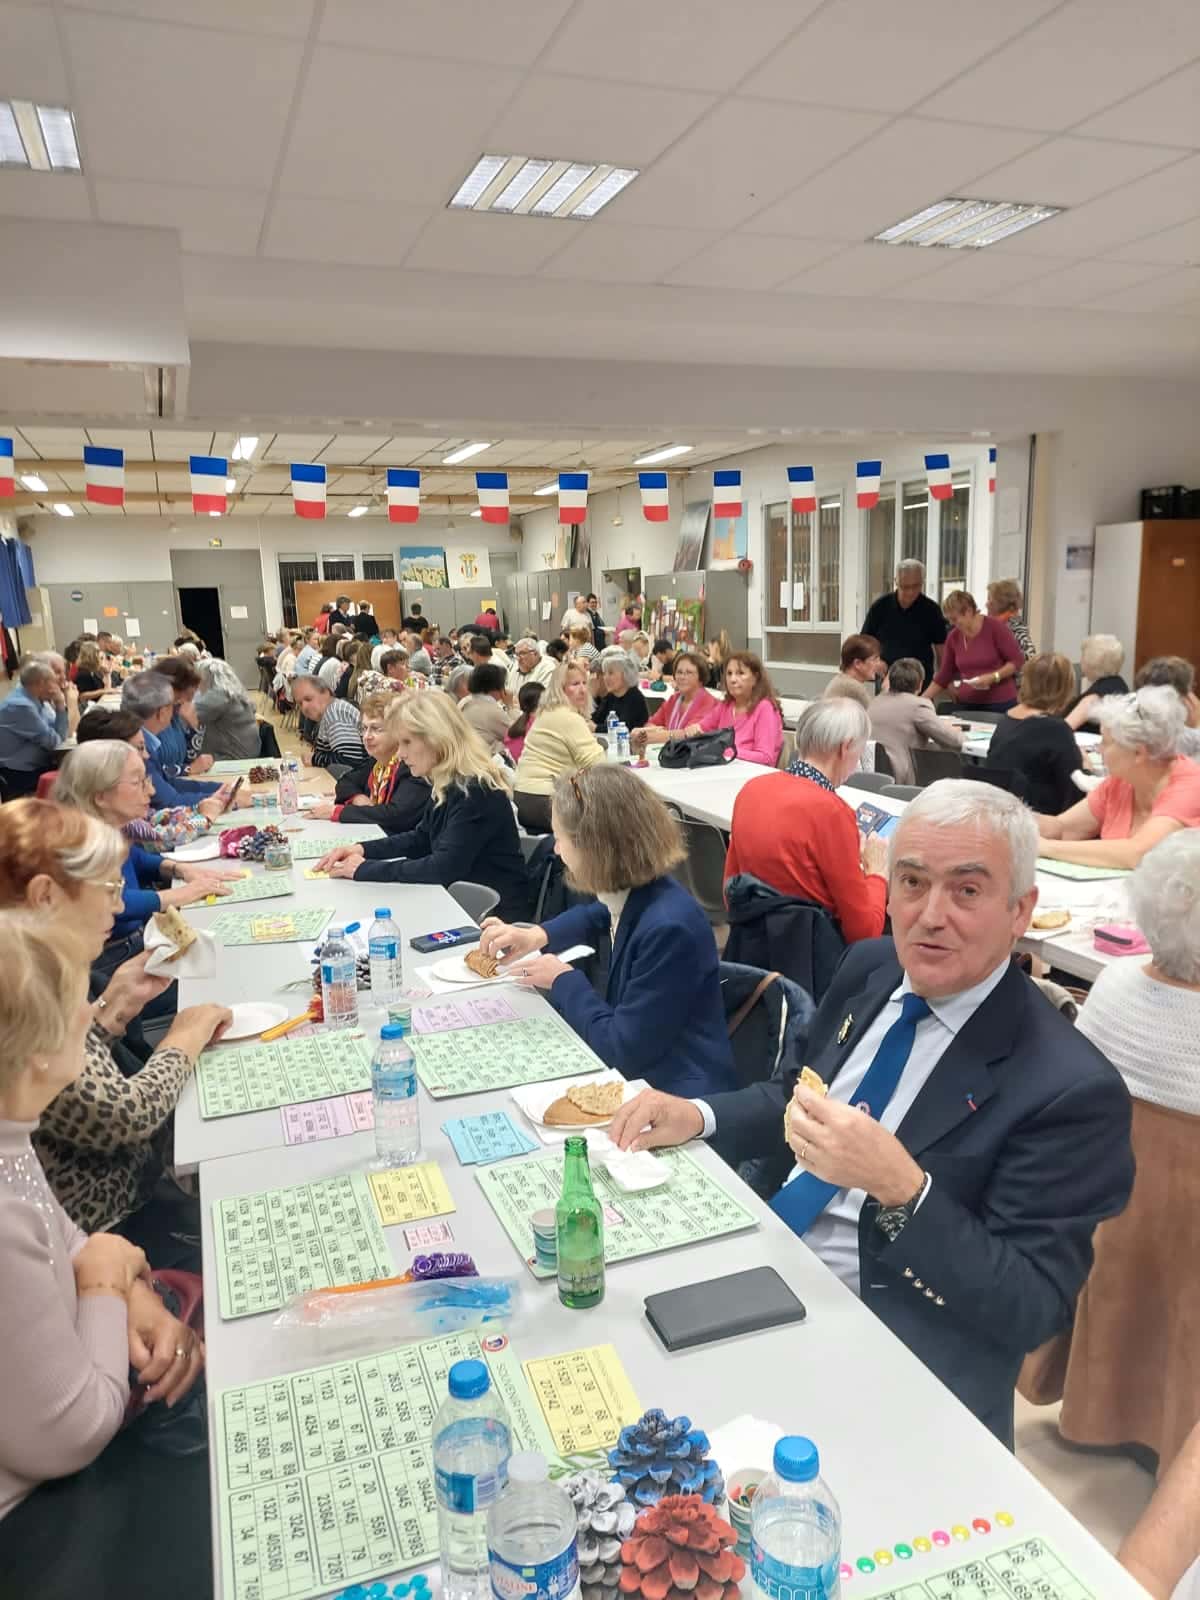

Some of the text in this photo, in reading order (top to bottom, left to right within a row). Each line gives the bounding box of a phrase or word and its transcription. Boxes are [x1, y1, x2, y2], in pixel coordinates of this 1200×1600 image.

[366, 1368, 378, 1379] 10
[350, 1423, 364, 1433] 67
[310, 1444, 322, 1457] 70
[236, 1463, 249, 1474] 77
[363, 1481, 377, 1494] 20
[287, 1491, 300, 1504] 16
[264, 1509, 278, 1522] 22
[289, 1513, 304, 1528] 32
[338, 1478, 352, 1489] 13
[352, 1546, 367, 1561] 79
[240, 1527, 254, 1540] 34
[291, 1527, 305, 1540] 42
[242, 1551, 257, 1565] 50
[294, 1551, 309, 1563] 67
[327, 1553, 342, 1568] 72
